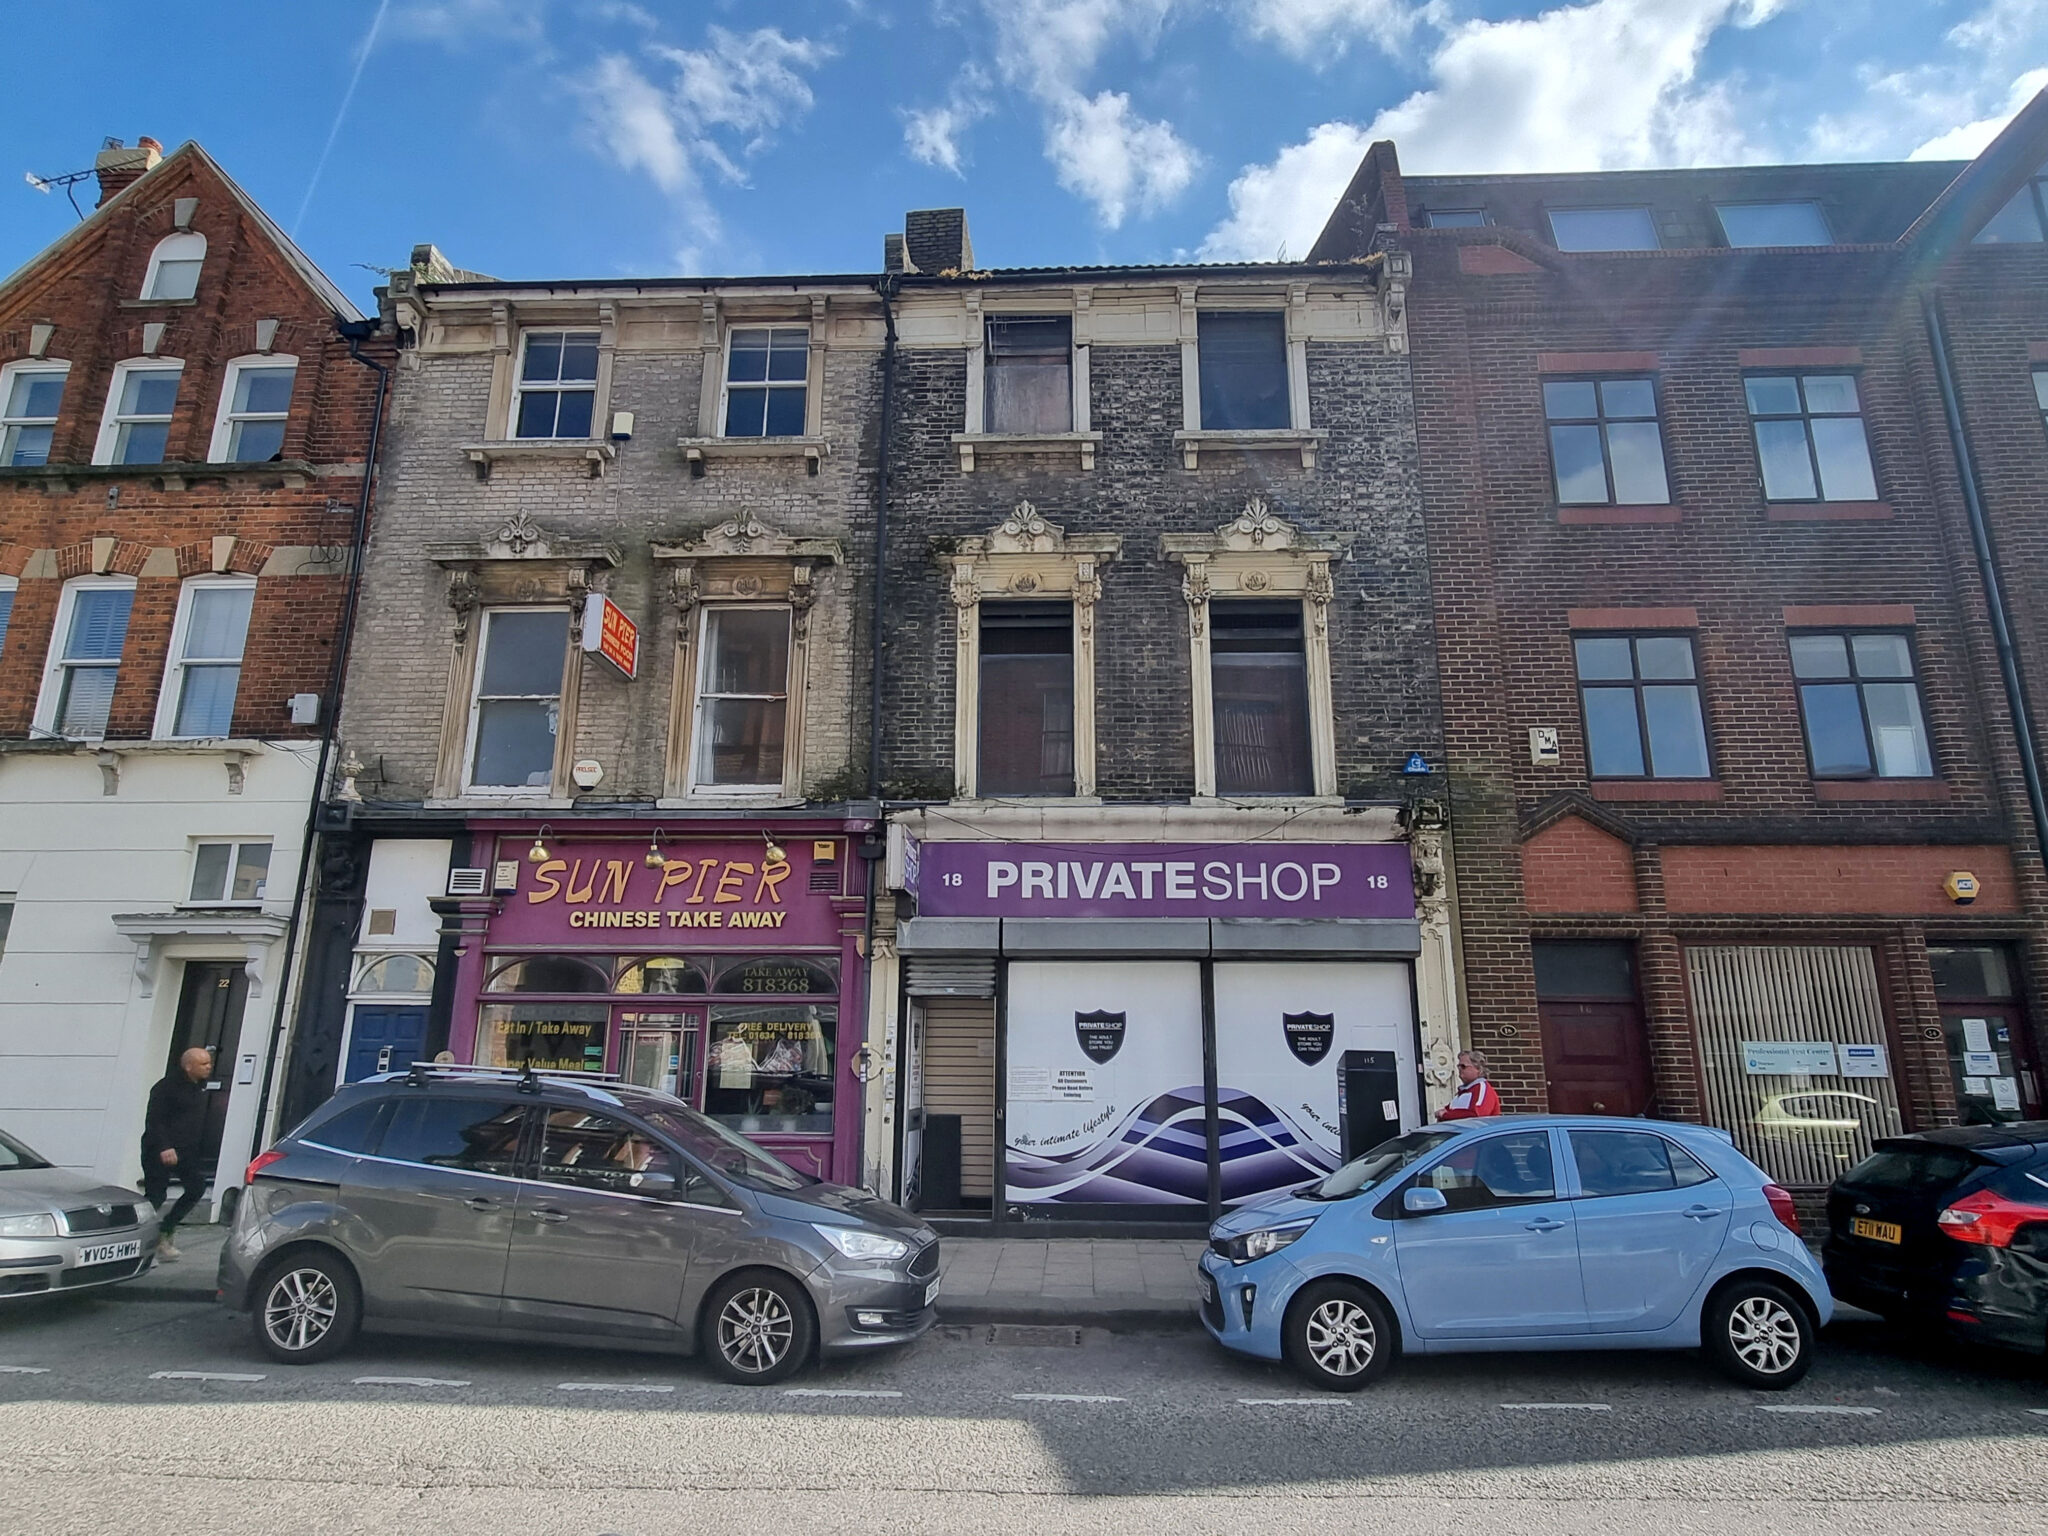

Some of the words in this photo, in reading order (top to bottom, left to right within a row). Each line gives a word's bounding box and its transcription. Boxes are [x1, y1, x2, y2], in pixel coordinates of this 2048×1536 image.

[603, 606, 618, 633] SUN
[618, 619, 635, 648] PIER
[528, 858, 634, 904] SUN
[654, 859, 792, 904] PIER
[942, 873, 963, 887] 18
[1367, 876, 1389, 889] 18
[569, 911, 661, 928] CHINESE
[666, 911, 722, 928] TAKE
[728, 911, 787, 928] AWAY
[743, 967, 772, 977] TAKE
[775, 967, 810, 977] AWAY
[218, 979, 230, 988] 22
[743, 978, 810, 992] 818368
[497, 1022, 513, 1034] Eat
[516, 1022, 526, 1034] In
[536, 1022, 560, 1035] Take
[562, 1022, 592, 1038] Away
[766, 1022, 813, 1031] DELIVERY
[1301, 1103, 1321, 1121] your
[1040, 1129, 1080, 1146] intimate
[1083, 1105, 1116, 1133] lifestyle
[84, 1246, 115, 1262] WV05
[116, 1242, 137, 1258] HWH
